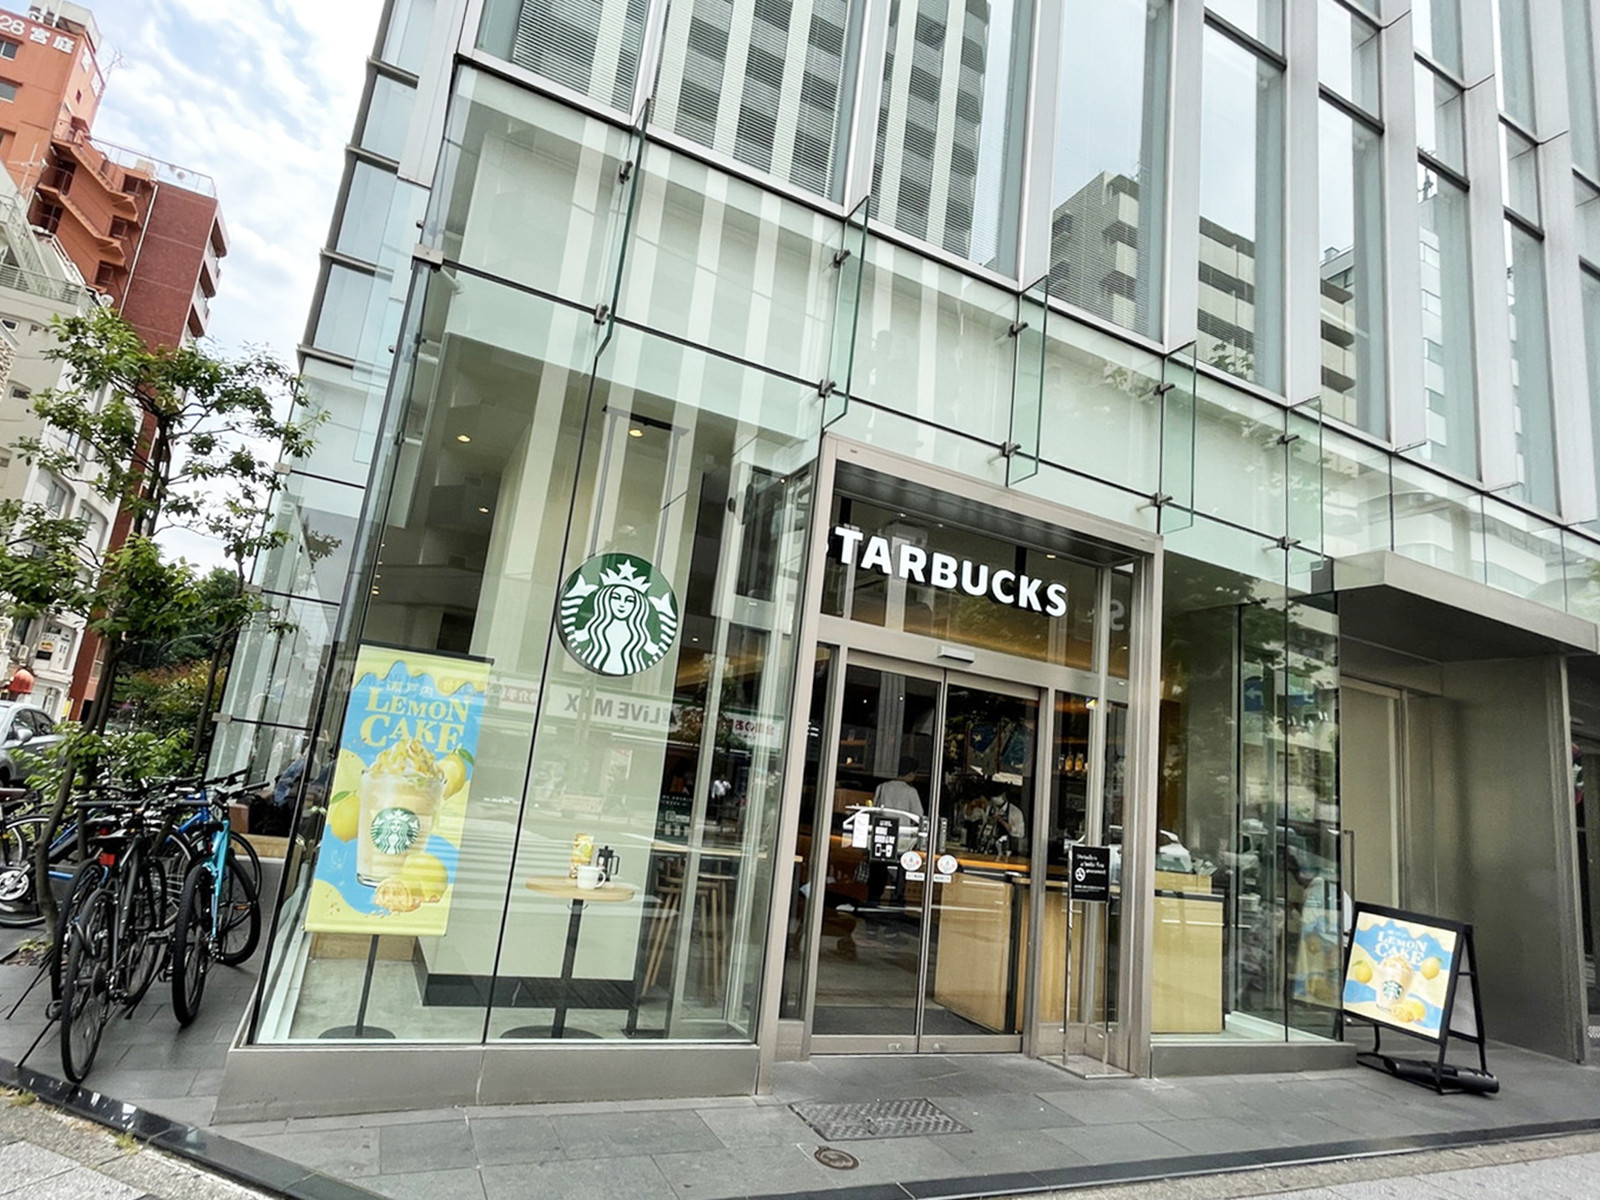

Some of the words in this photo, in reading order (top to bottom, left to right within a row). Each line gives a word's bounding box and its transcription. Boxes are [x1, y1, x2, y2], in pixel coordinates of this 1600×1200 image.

[826, 526, 1067, 617] TARBUCKS
[365, 686, 470, 723] LEMON
[360, 714, 464, 753] CAKE
[1374, 942, 1424, 966] CAKE
[1377, 930, 1428, 953] LEMON
